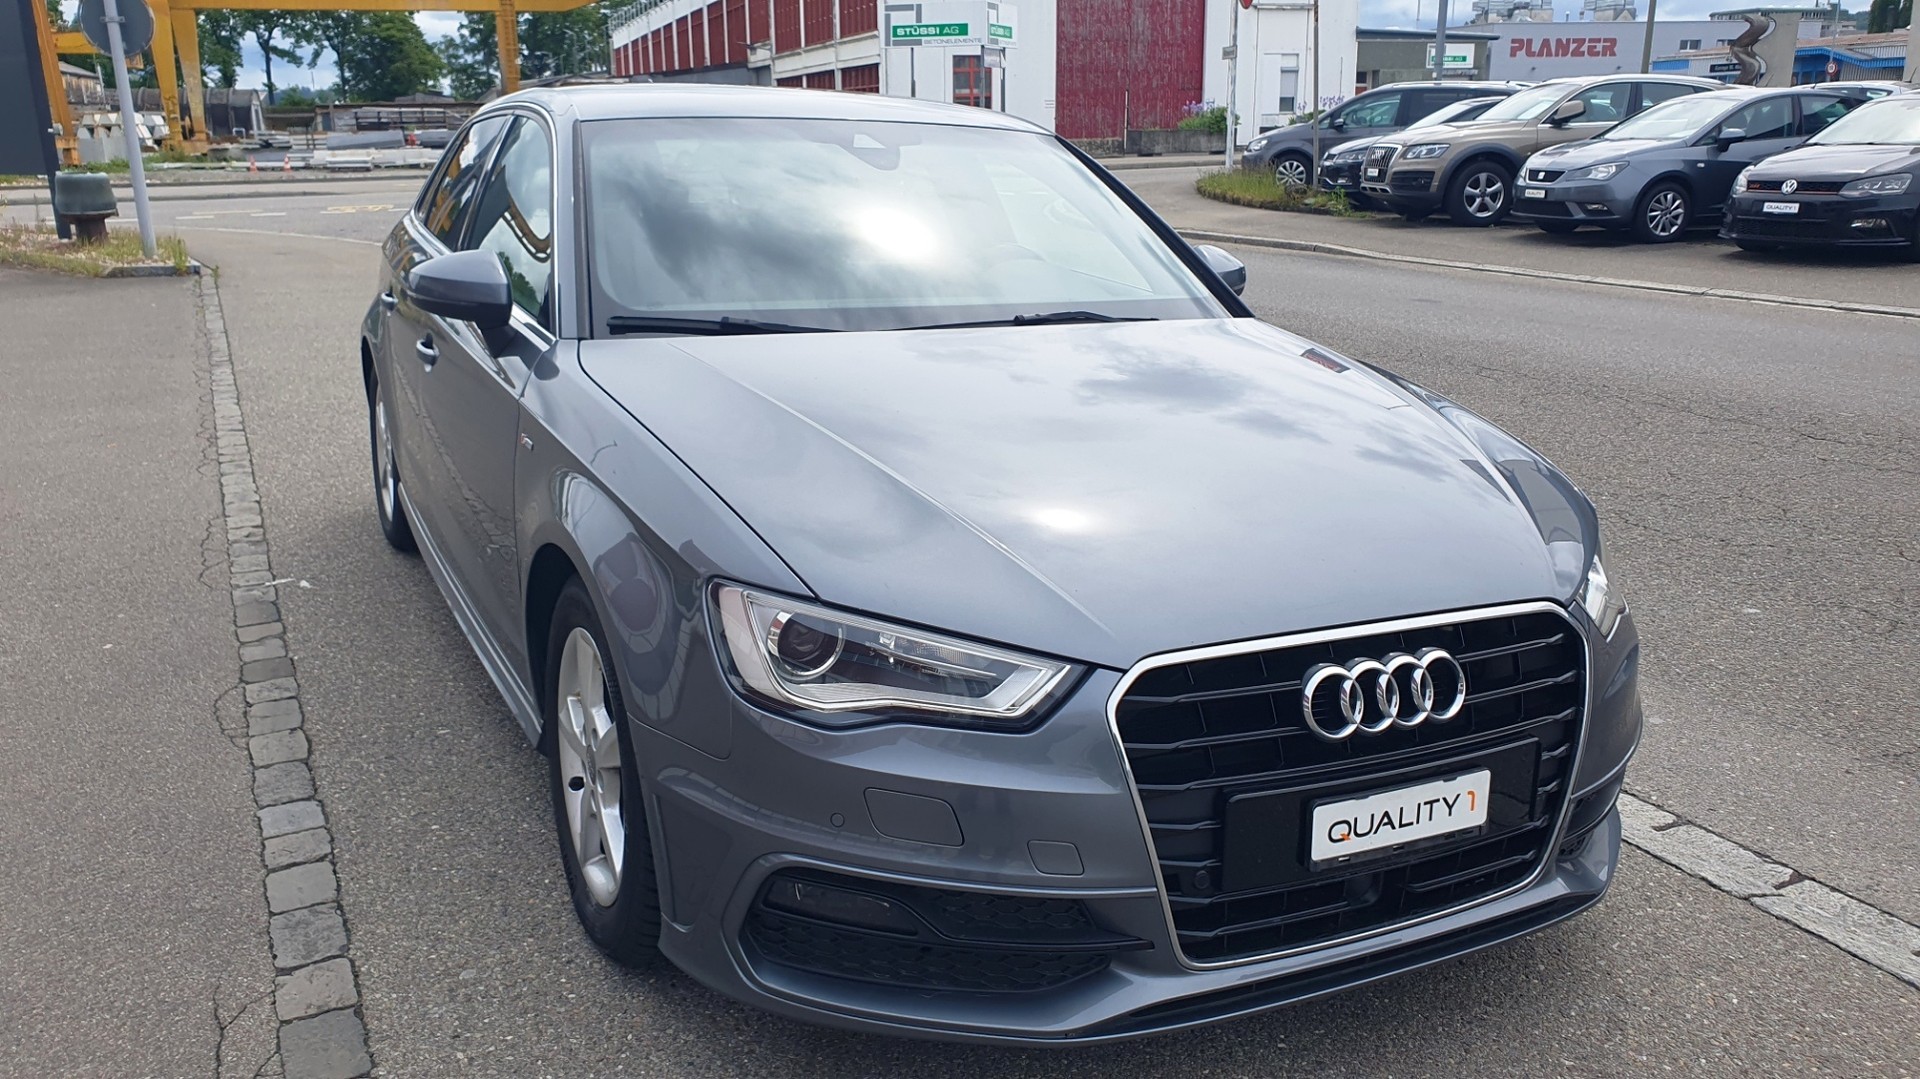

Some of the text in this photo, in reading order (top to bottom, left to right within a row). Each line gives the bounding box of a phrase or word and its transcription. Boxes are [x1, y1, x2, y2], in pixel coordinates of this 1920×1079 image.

[896, 26, 959, 35] STÜSSI AG
[923, 37, 983, 46] BETONELEMENTE
[1509, 37, 1618, 58] PLANZER
[1327, 788, 1477, 844] QUALITY 1
